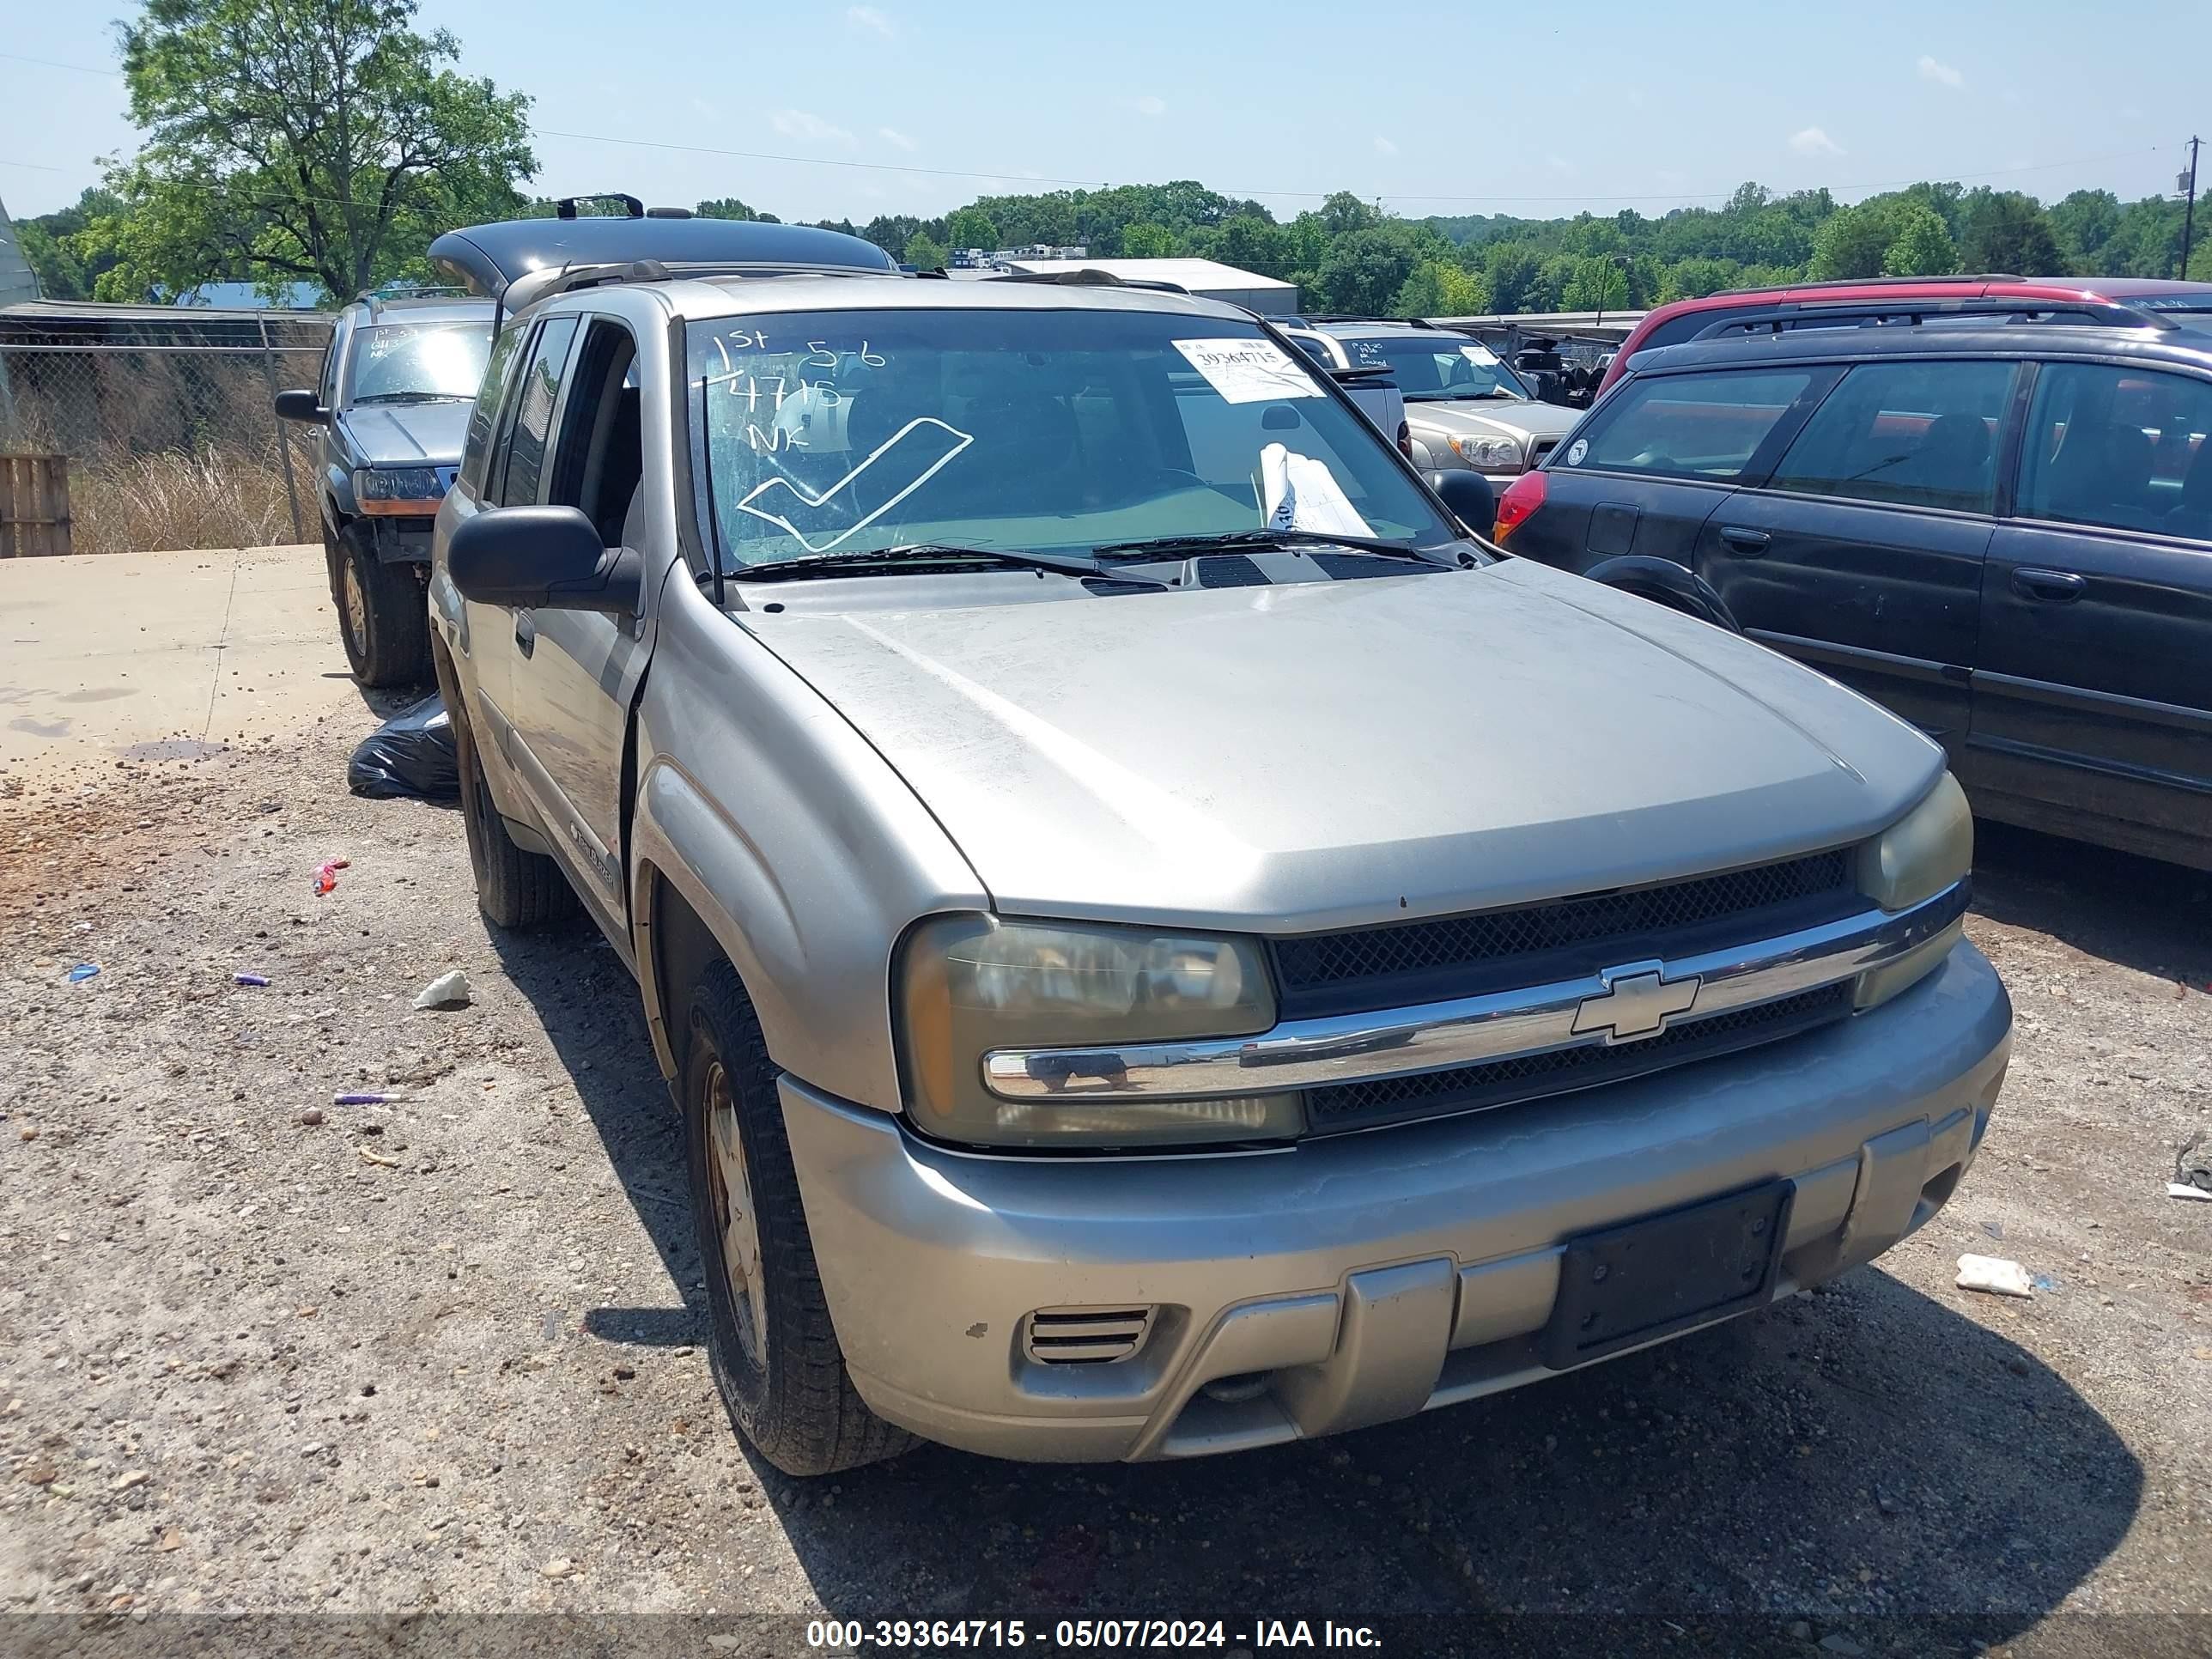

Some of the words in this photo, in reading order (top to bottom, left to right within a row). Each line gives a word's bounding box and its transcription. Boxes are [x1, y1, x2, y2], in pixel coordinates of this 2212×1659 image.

[692, 330, 769, 388] 1st
[1196, 350, 1279, 367] 39364715
[729, 375, 842, 413] 4715
[745, 423, 811, 453] NK
